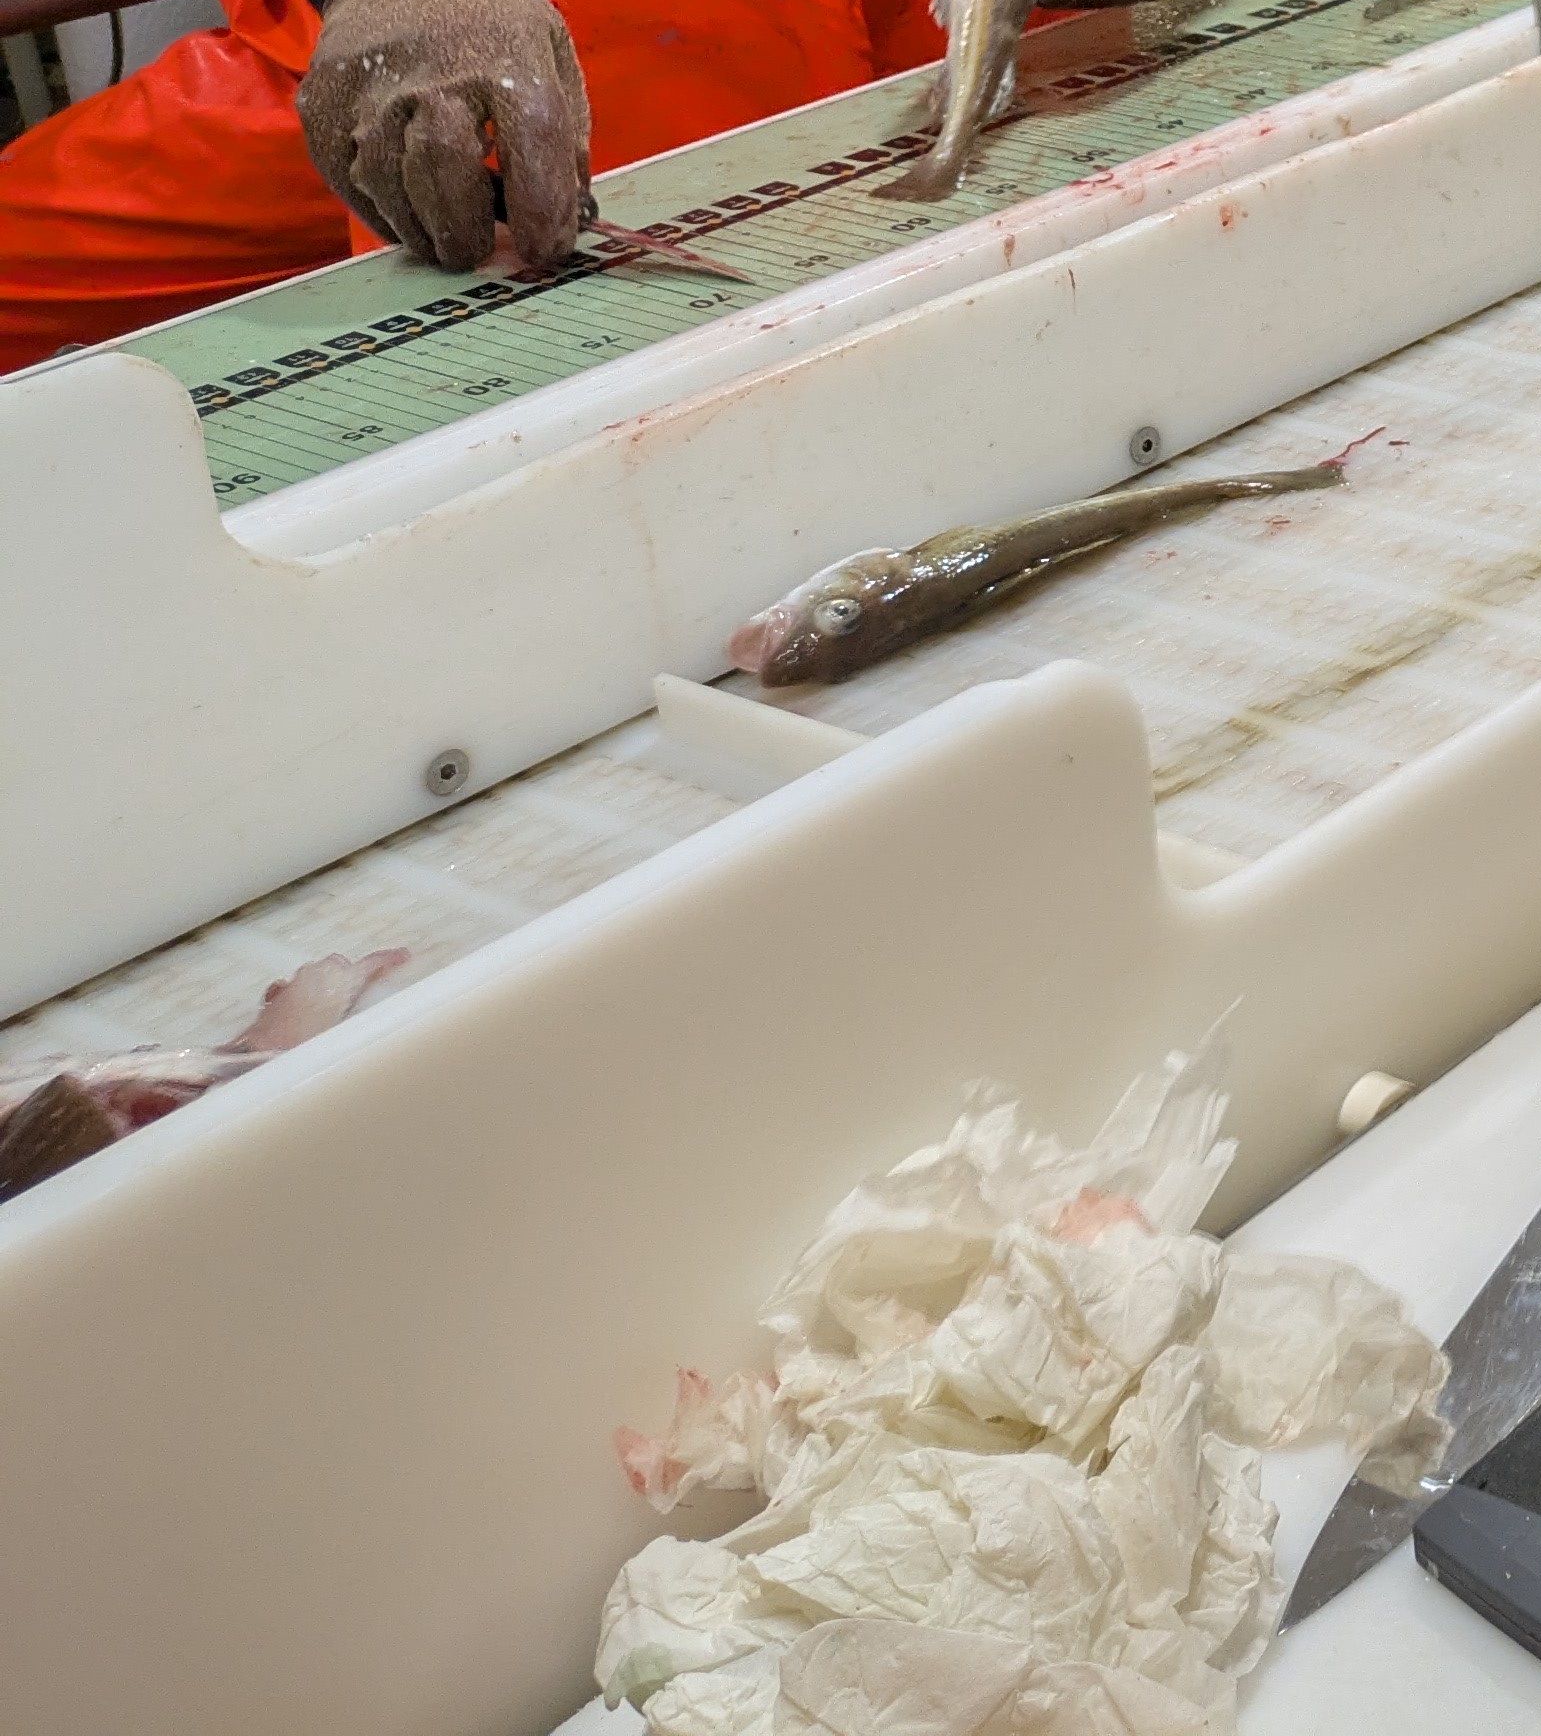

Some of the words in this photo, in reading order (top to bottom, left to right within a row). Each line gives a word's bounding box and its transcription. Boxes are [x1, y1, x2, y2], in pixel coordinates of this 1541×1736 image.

[891, 217, 932, 232] 60
[689, 292, 733, 310] 70
[580, 334, 622, 351] 75
[463, 376, 511, 397] 80
[342, 424, 383, 442] 85
[213, 473, 261, 494] 90
